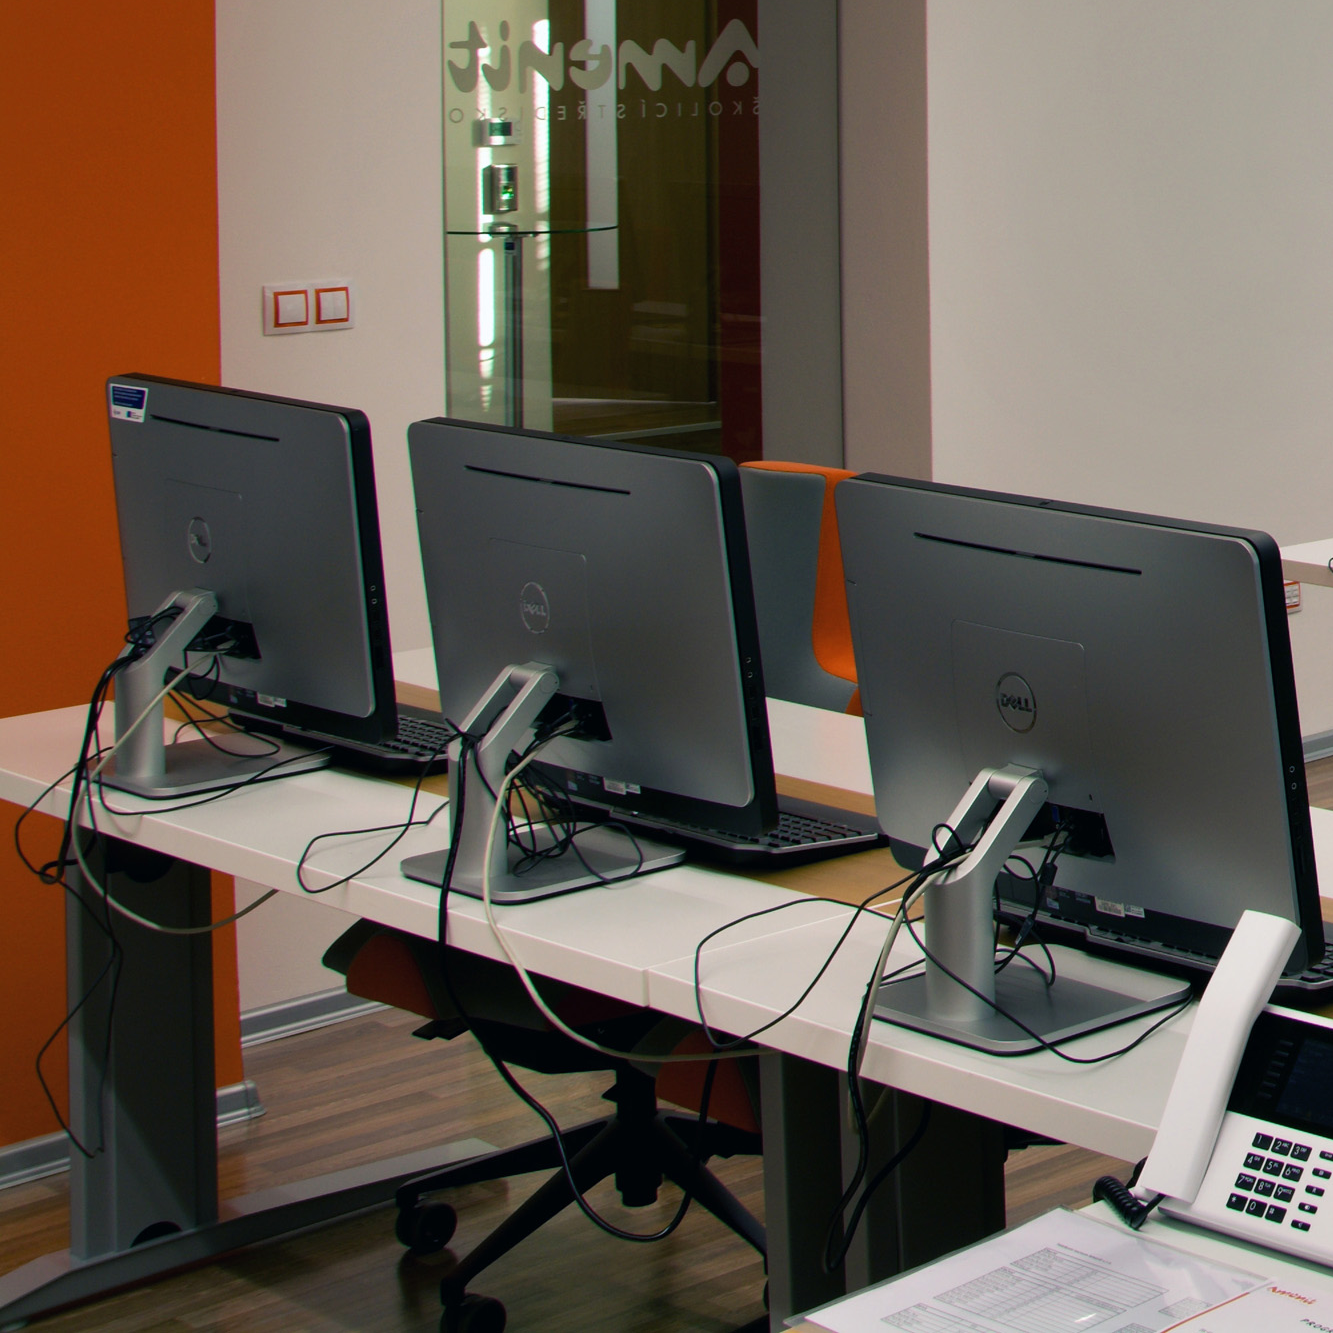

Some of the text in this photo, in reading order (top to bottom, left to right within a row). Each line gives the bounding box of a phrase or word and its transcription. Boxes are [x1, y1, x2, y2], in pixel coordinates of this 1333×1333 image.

[1000, 692, 1033, 713] DELL
[1275, 1141, 1282, 1150] 2
[1294, 1146, 1301, 1155] 3
[1266, 1161, 1273, 1170] 5
[1285, 1167, 1292, 1176] 6
[1258, 1182, 1265, 1191] 8
